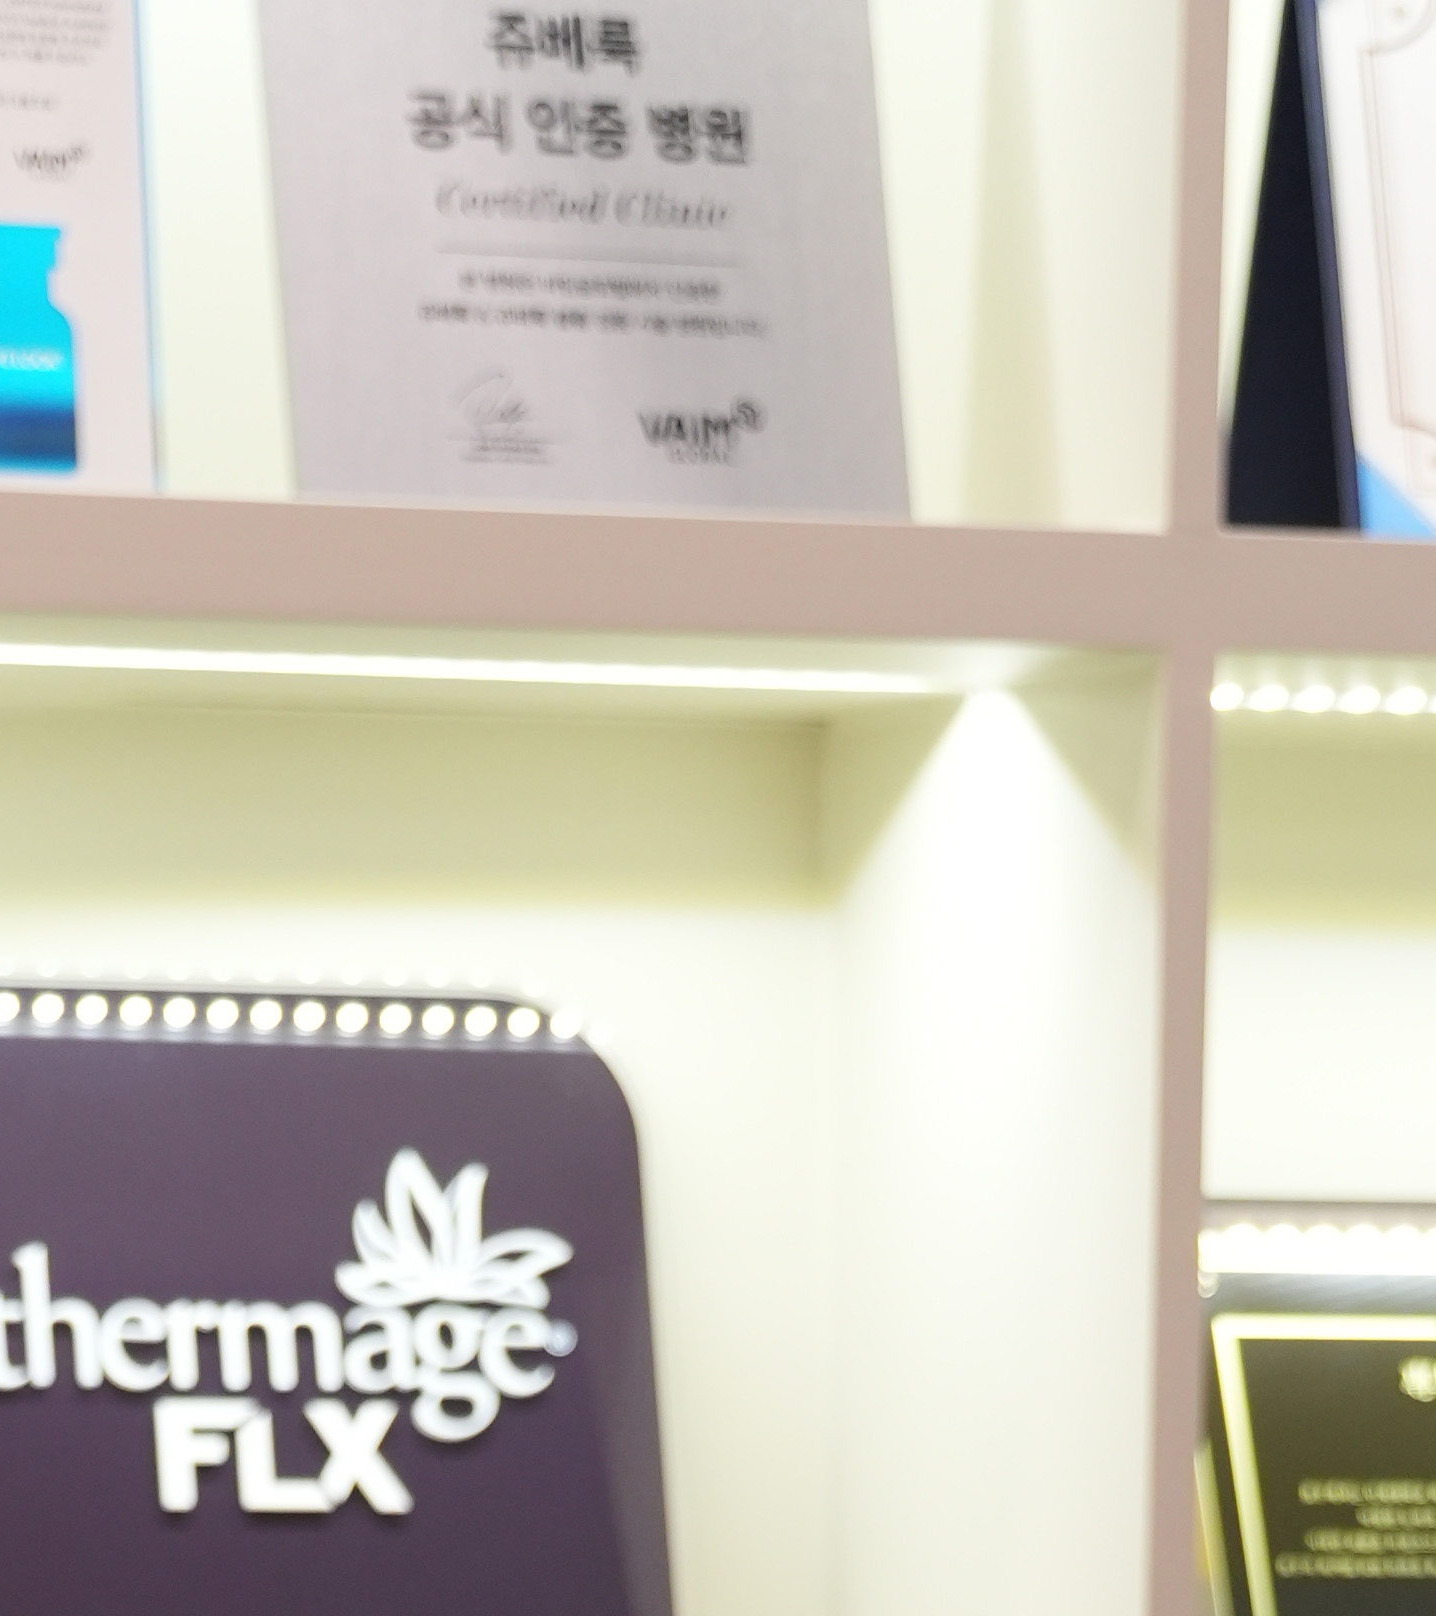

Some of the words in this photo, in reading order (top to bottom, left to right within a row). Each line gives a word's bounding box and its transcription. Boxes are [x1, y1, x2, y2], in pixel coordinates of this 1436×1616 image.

[490, 11, 640, 74] 쥬베룩
[406, 90, 513, 152] 공식
[524, 97, 628, 160] 인증
[647, 101, 750, 164] 병원
[153, 1396, 415, 1516] FLX
